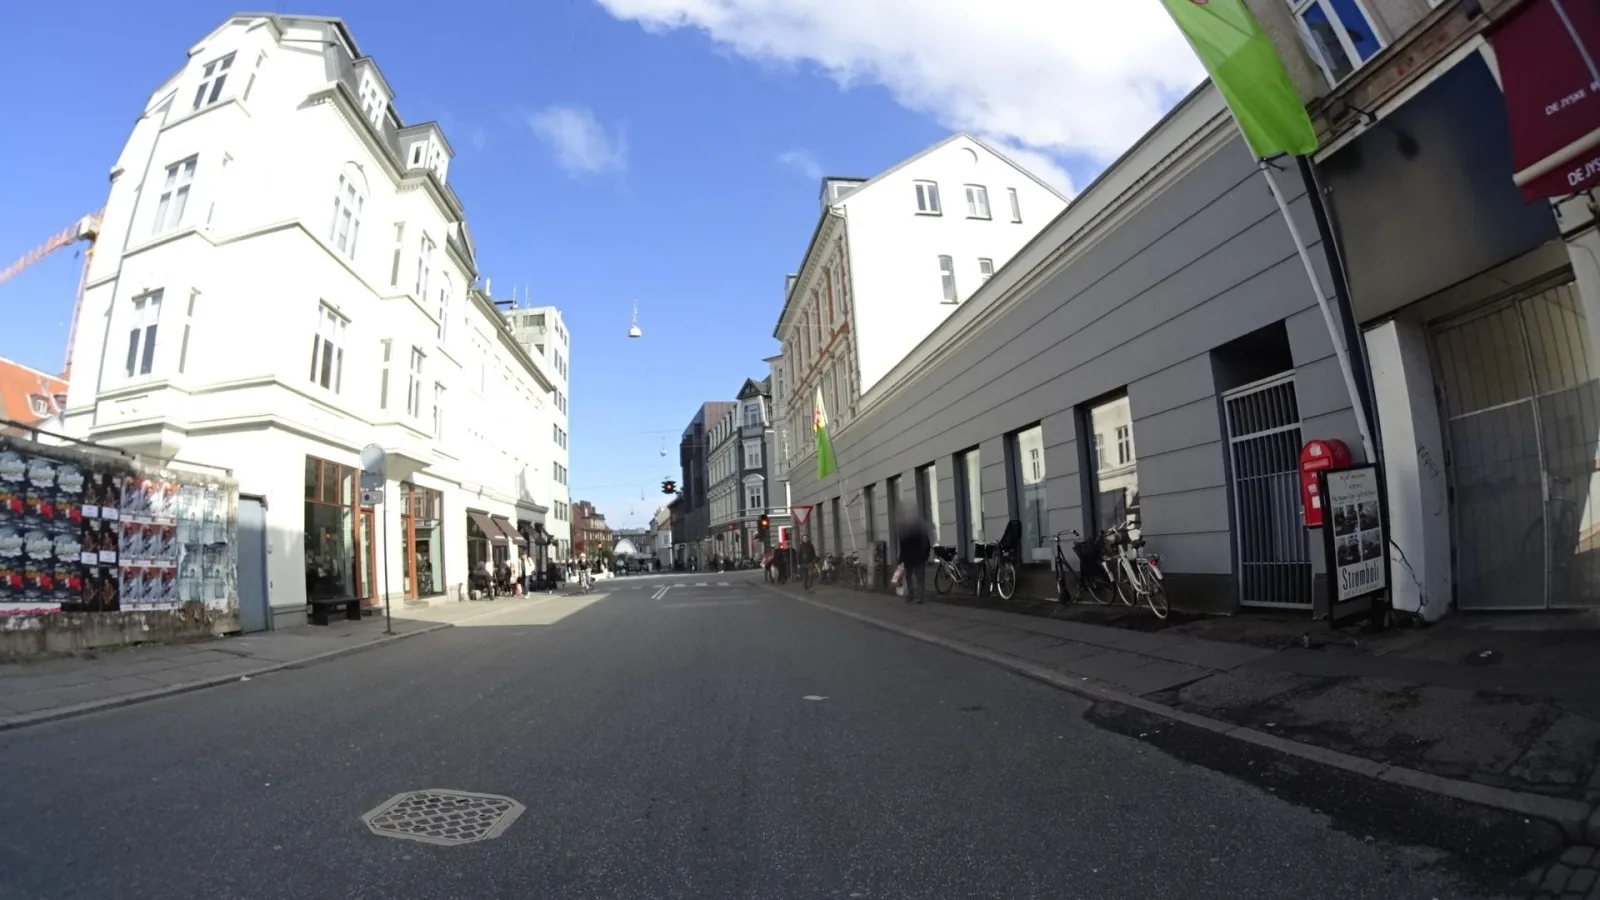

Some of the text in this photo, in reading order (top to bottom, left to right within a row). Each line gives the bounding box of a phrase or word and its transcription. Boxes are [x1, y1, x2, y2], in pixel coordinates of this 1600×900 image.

[1545, 89, 1587, 116] DE JYSKE
[1567, 168, 1585, 186] DE
[1342, 559, 1380, 591] Stromboli
